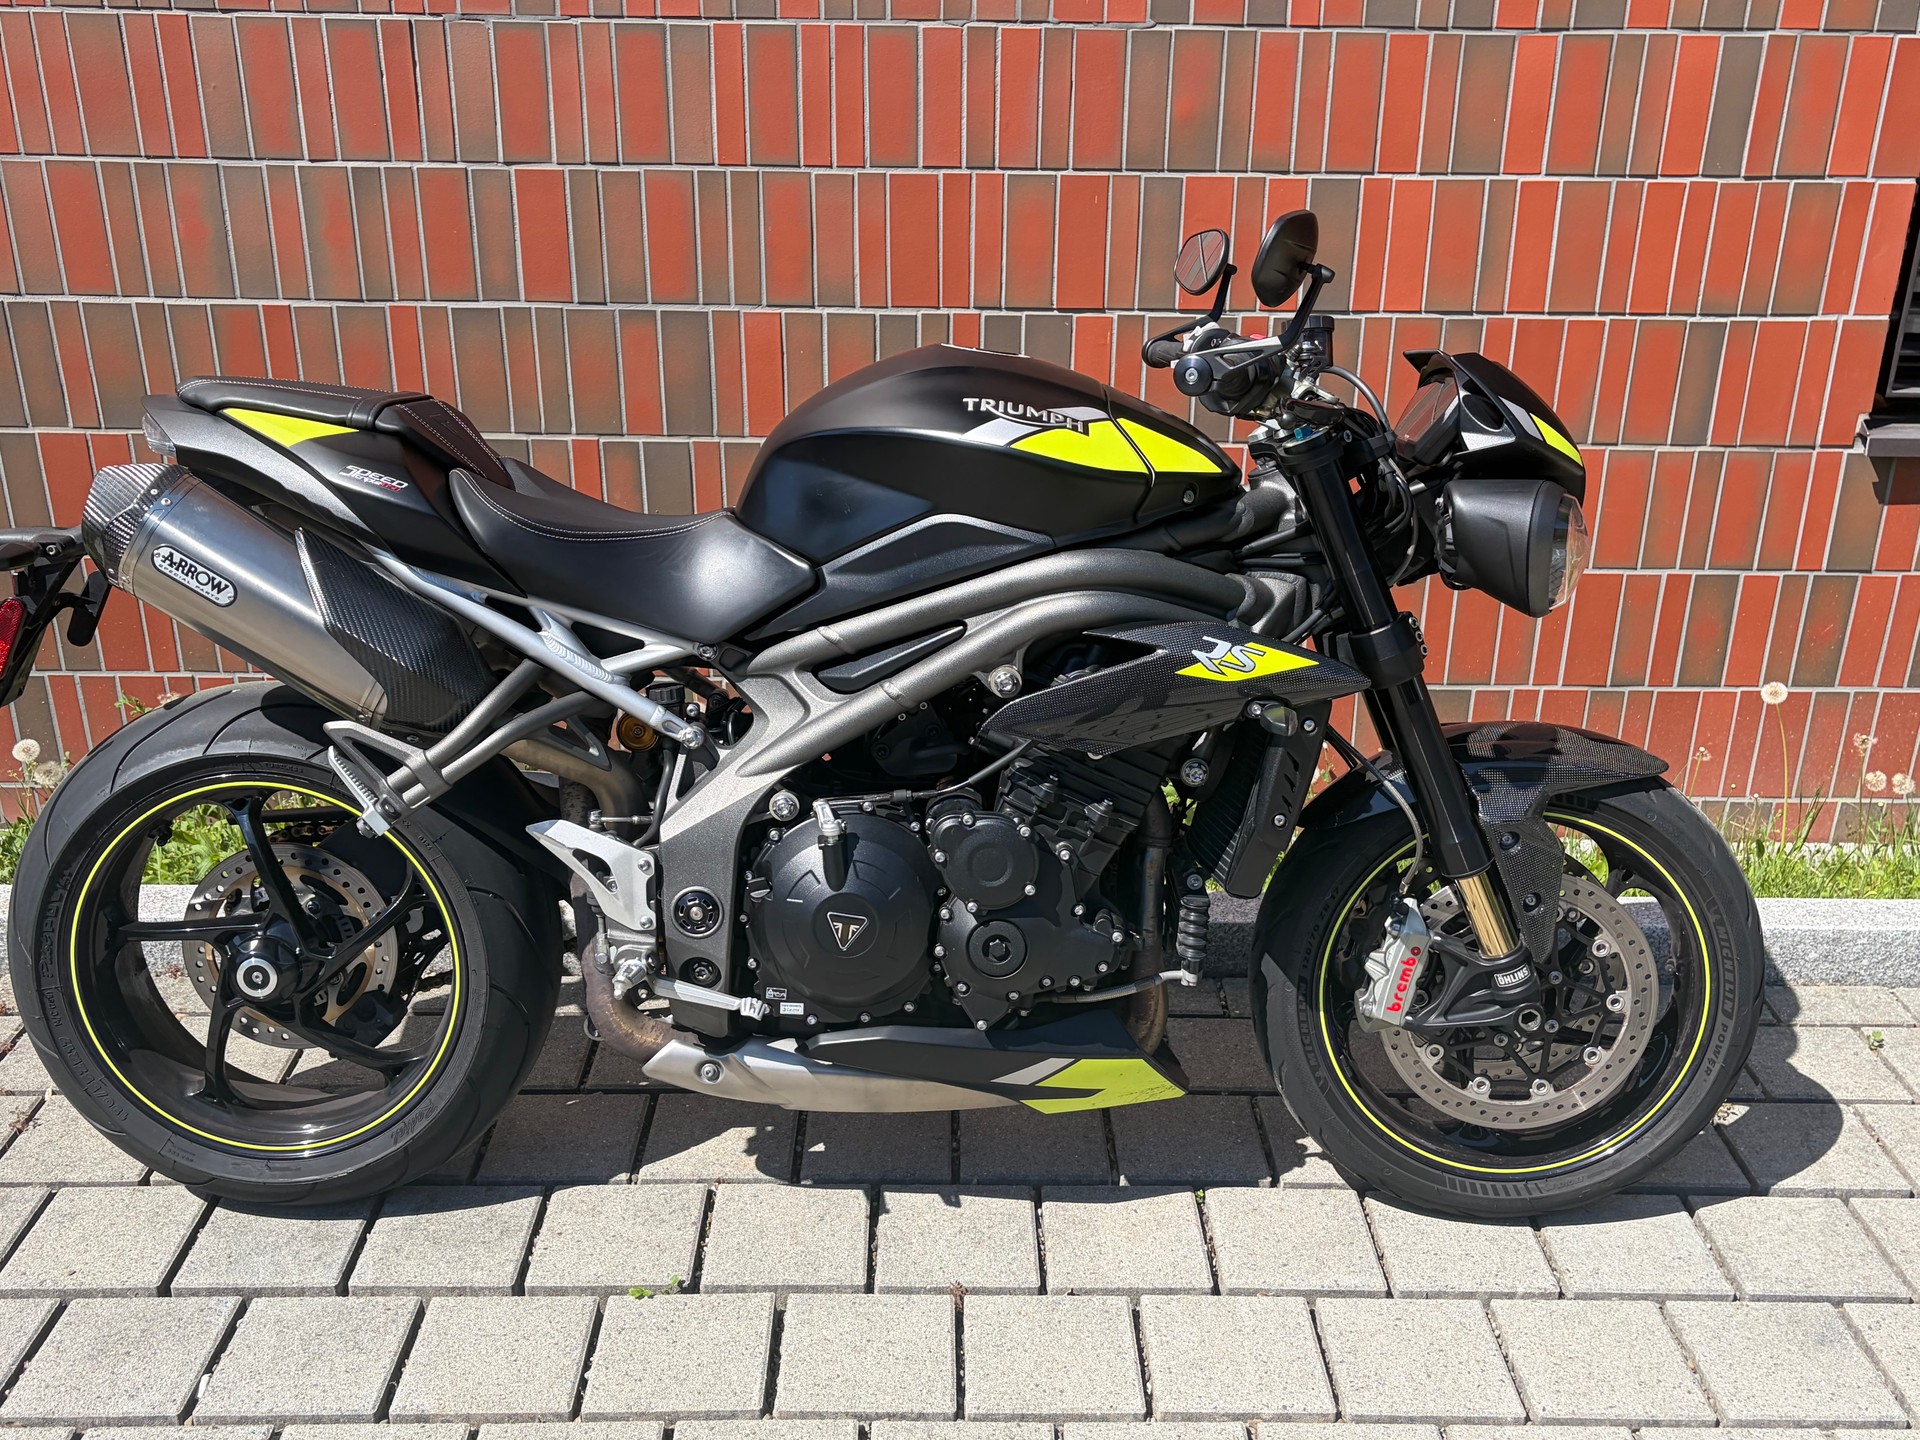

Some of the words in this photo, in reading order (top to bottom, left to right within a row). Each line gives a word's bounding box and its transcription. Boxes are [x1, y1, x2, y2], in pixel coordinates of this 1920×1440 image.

[962, 398, 1084, 433] TRIUMPH
[338, 465, 409, 489] SPEED
[160, 551, 230, 595] ARROW
[1191, 635, 1266, 677] RS
[1386, 946, 1421, 1013] brembo
[1716, 926, 1735, 1014] MICHELIN
[1703, 1022, 1729, 1078] POWER
